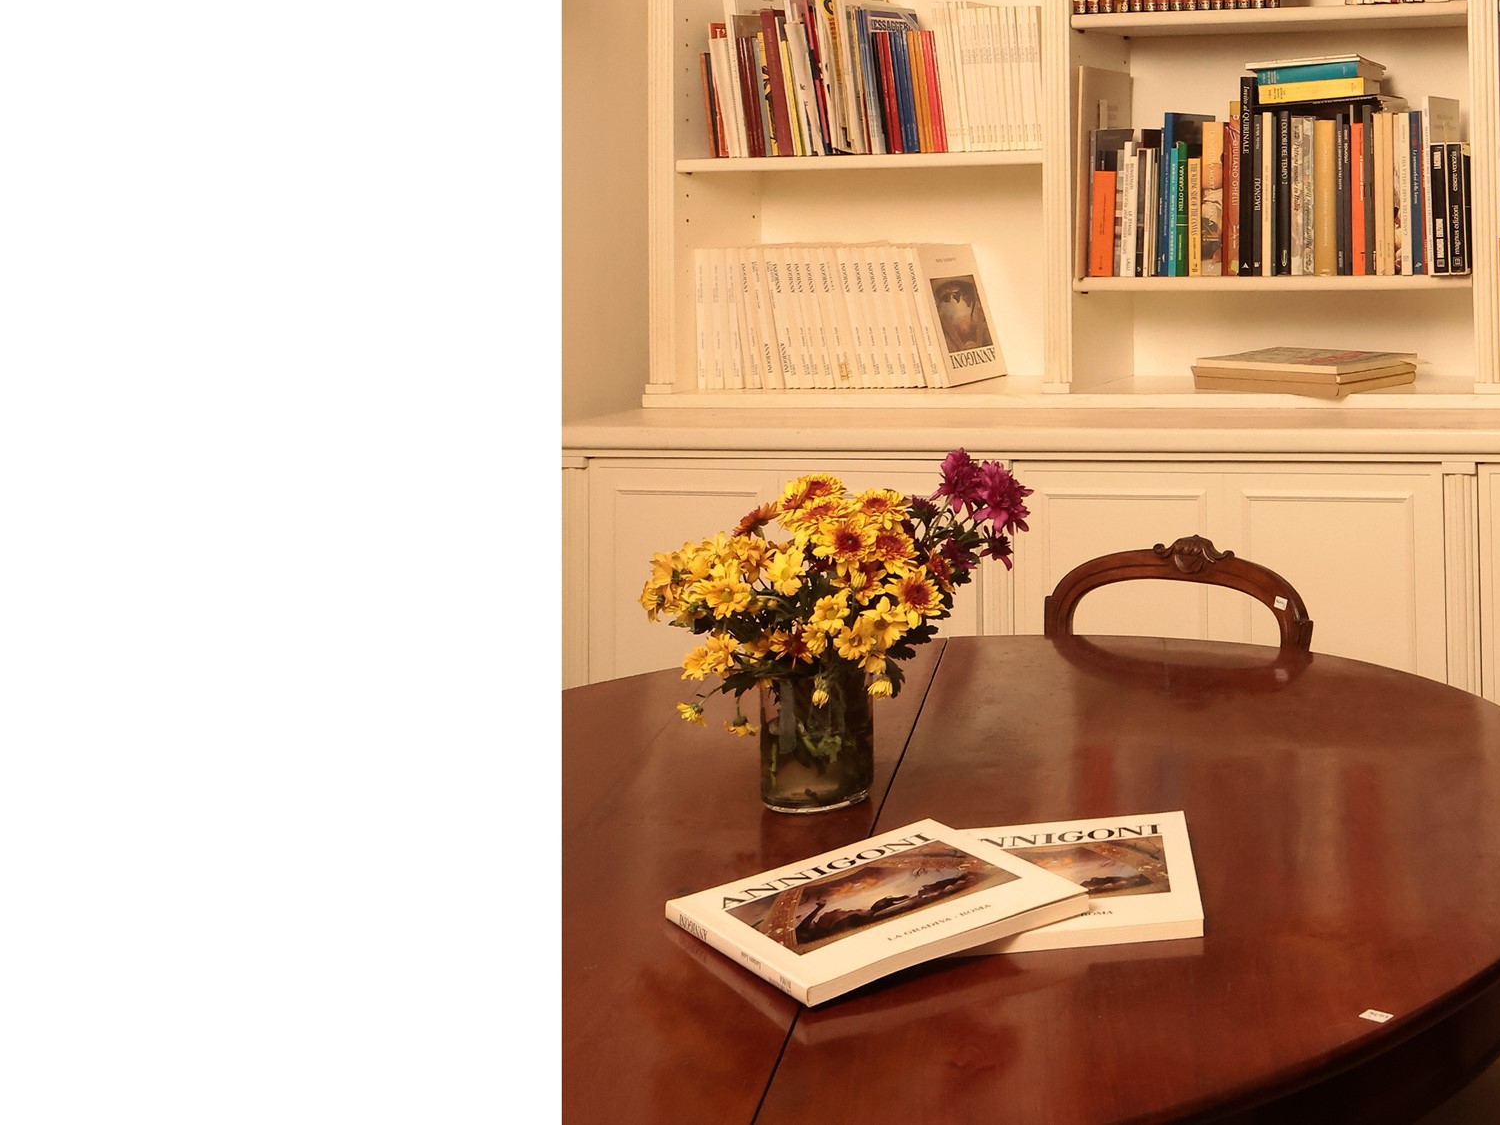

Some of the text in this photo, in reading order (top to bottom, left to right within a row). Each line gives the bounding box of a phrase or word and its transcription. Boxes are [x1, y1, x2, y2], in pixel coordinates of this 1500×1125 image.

[1436, 218, 1444, 258] MAGNUS EDIZIONI
[1452, 205, 1461, 255] magnus edizioni
[950, 347, 996, 370] ANNIGONI
[978, 823, 1163, 848] NNIGONI
[721, 832, 936, 910] ANNIGONI
[680, 913, 709, 941] ANNIGONI
[888, 903, 992, 942] LA GRADIVA ROMA
